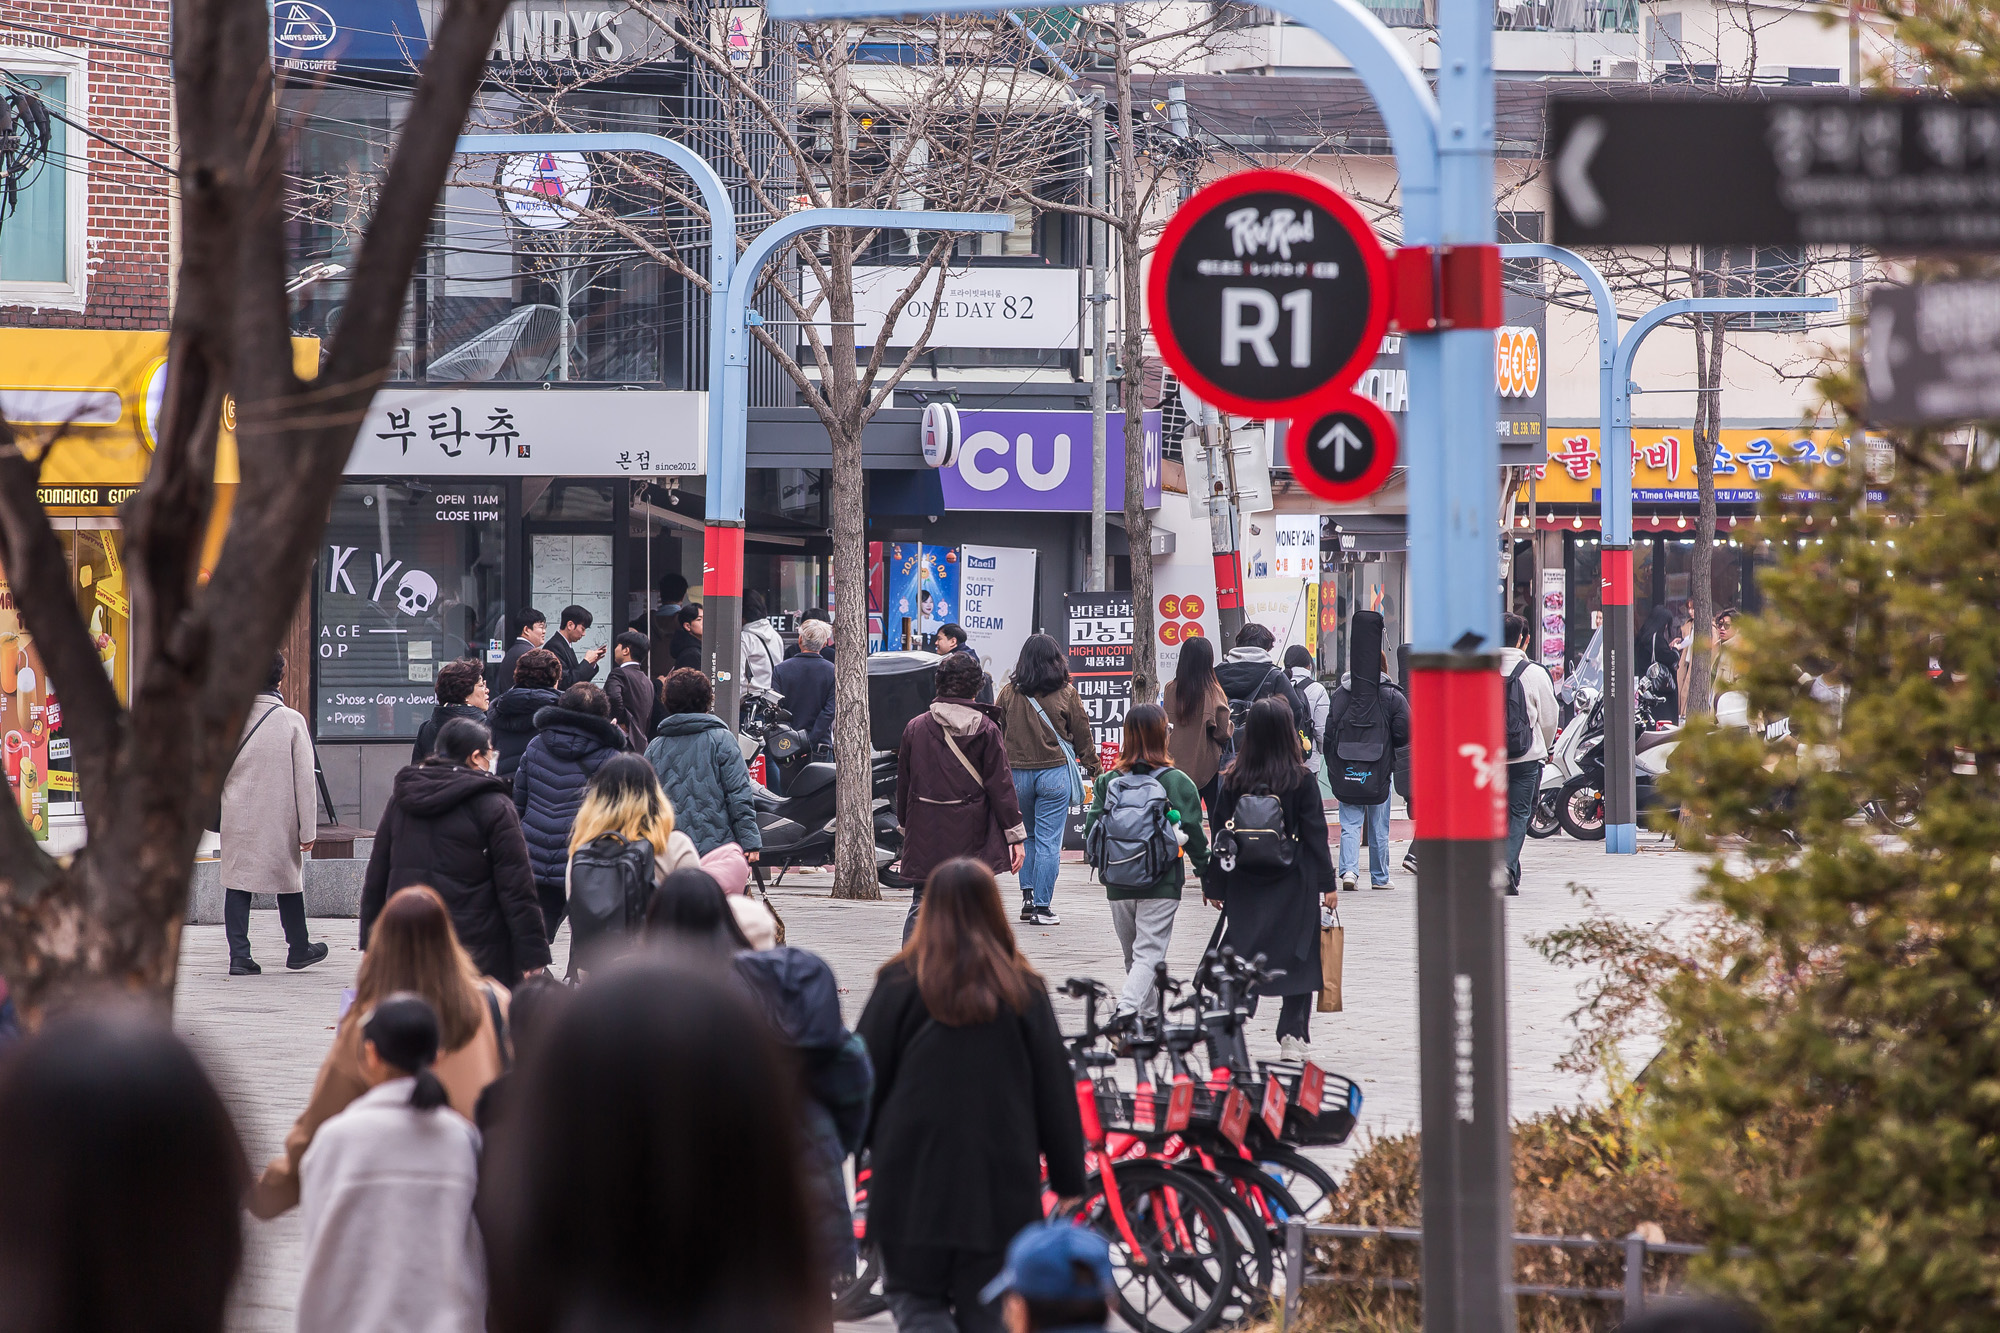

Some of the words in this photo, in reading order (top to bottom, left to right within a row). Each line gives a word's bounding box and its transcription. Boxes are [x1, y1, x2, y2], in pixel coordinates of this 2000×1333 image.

[728, 51, 749, 60] NDYS
[284, 59, 308, 70] ANDYS
[309, 60, 337, 71] COFFEE
[907, 301, 949, 318] ONE
[955, 302, 996, 318] DAY
[1003, 296, 1034, 319] 82
[1221, 287, 1313, 367] R1
[376, 407, 519, 458] 부탄츄
[616, 451, 650, 471] 본점
[655, 463, 697, 471] since2012
[958, 431, 1071, 491] CU
[1144, 430, 1158, 489] CU
[37, 489, 98, 503] GOMANGO
[436, 495, 465, 505] OPEN
[473, 495, 499, 505] 11AM
[436, 511, 470, 521] CLOSE
[473, 511, 499, 521] 11PM
[1302, 531, 1315, 546] 24h
[969, 559, 994, 568] Maeil
[966, 583, 994, 597] SOFT
[965, 600, 982, 612] ICE
[1069, 605, 1105, 618] 남다른
[964, 616, 1004, 630] CREAM
[1068, 646, 1094, 656] HIGH
[1096, 645, 1133, 656] NICOTIN
[1085, 656, 1125, 667] 제품취급
[1078, 681, 1132, 695] 대세는?
[335, 693, 366, 706] Shose
[376, 693, 397, 707] Cap
[406, 693, 439, 705] Jewel
[334, 712, 366, 725] Props
